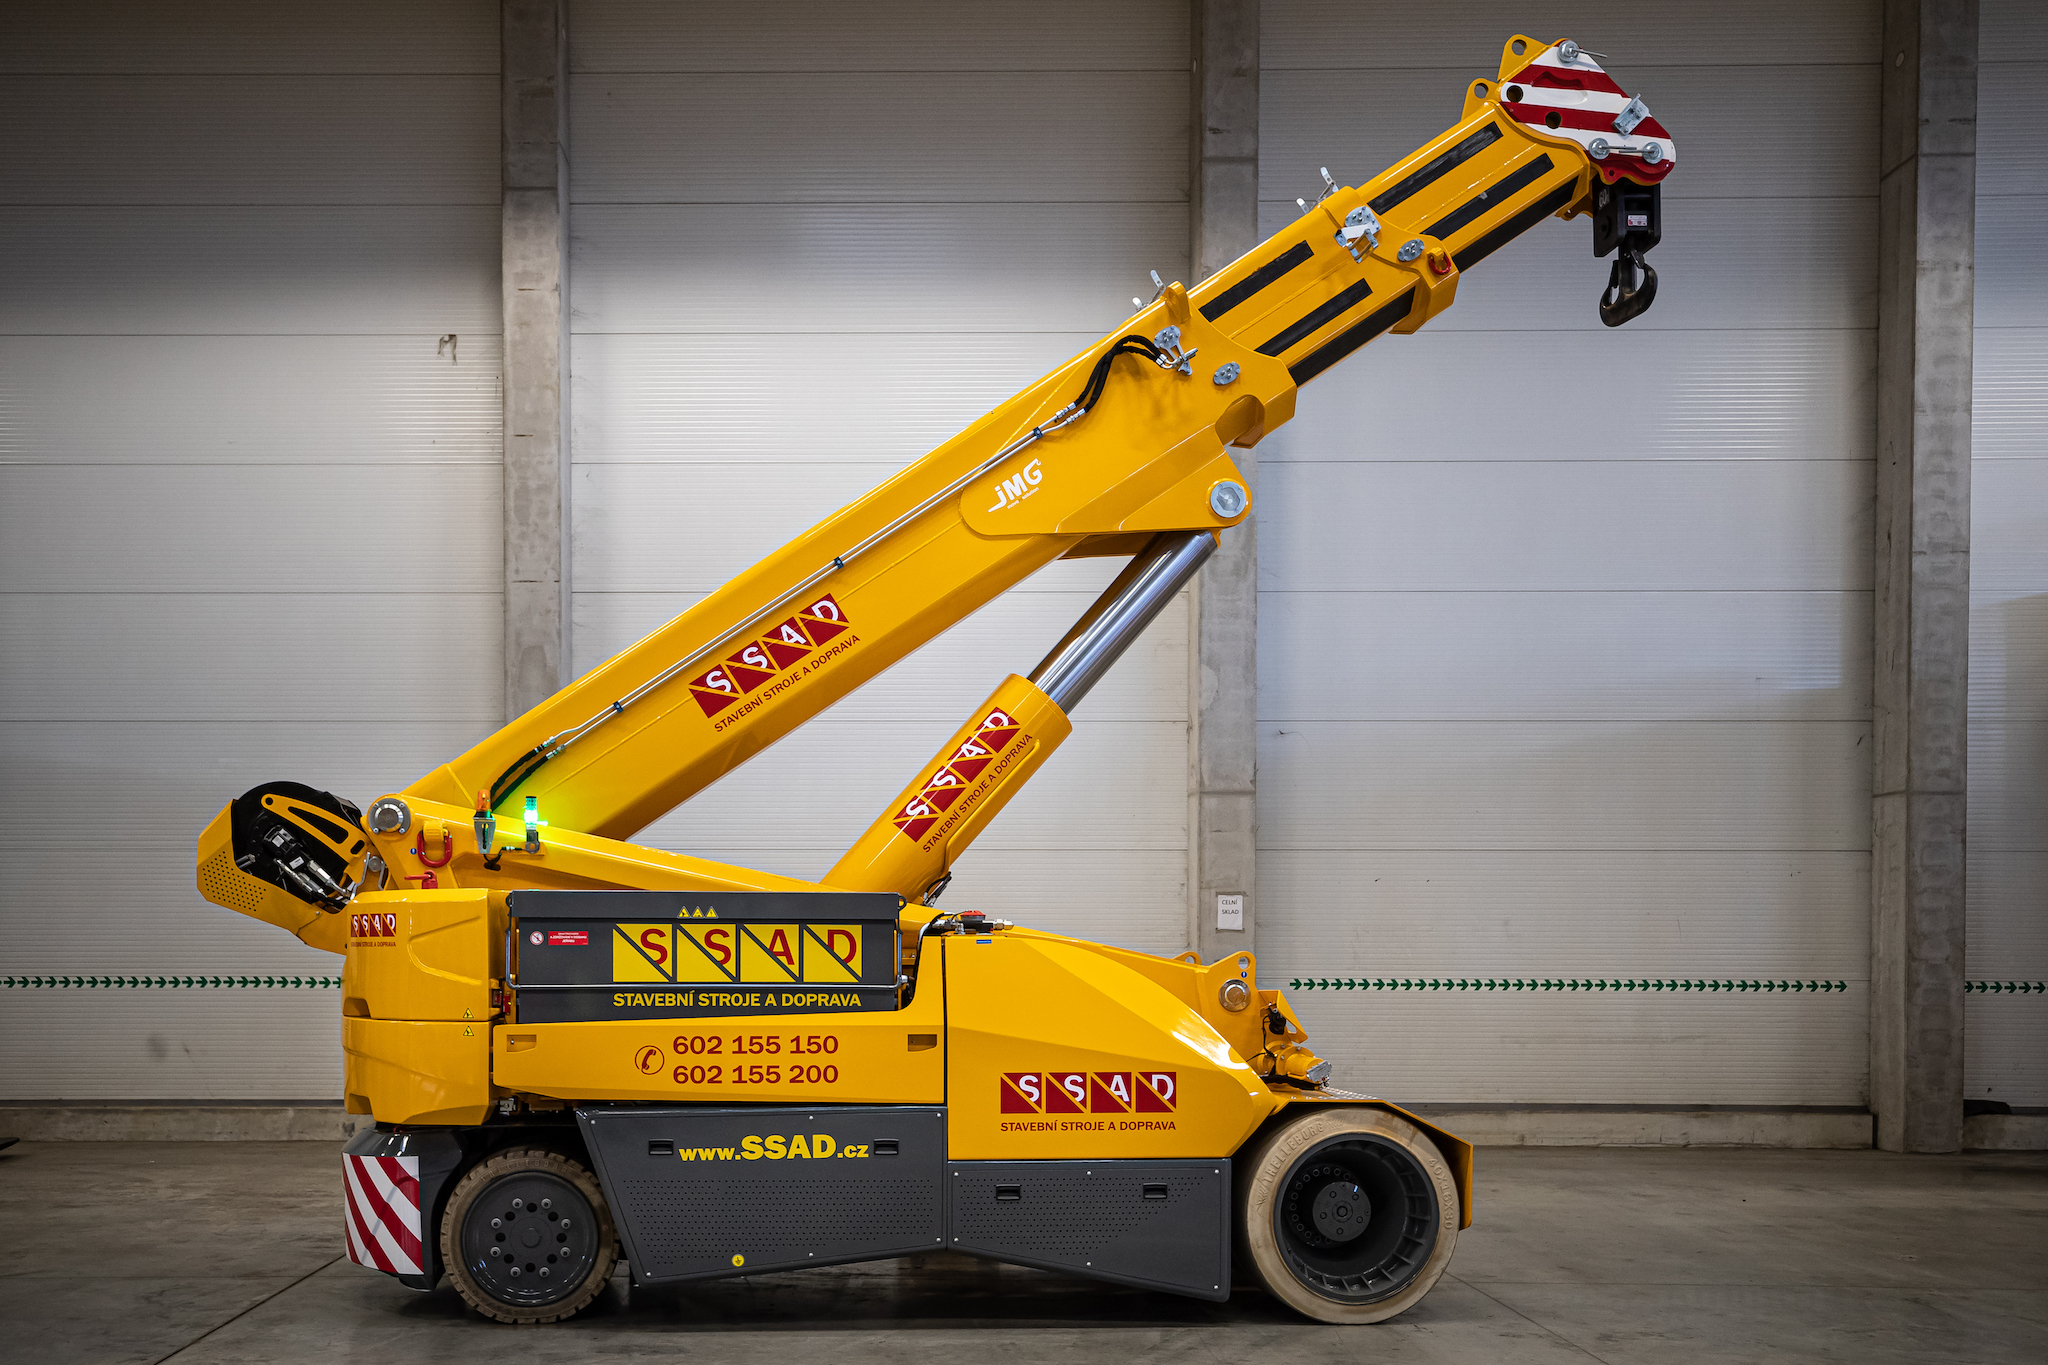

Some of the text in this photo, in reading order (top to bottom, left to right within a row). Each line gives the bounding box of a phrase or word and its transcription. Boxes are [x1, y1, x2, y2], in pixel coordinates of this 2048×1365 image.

[705, 599, 839, 692] SSAD
[714, 634, 861, 732] STAVEBNÍ STROJE A DOPRAVA
[905, 712, 1009, 816] SSAD
[922, 734, 1033, 853] STAVEBNÍ STROJE A DOPRAVA
[1221, 898, 1238, 906] CELNÍ
[353, 914, 396, 931] SSAD
[613, 990, 862, 1007] STAVEBNÍ STROJE A DOPRAVA
[673, 1035, 839, 1055] 602 155 150
[673, 1065, 839, 1084] 602 155 200
[1018, 1074, 1175, 1103] SSAD
[1000, 1119, 1177, 1132] STAVEBNÍ STROJE A DOPRAVA
[678, 1133, 869, 1161] www.SSAD.cz
[1263, 1123, 1325, 1184] TRELLEBORG
[1428, 1158, 1454, 1230] 40X16X30
